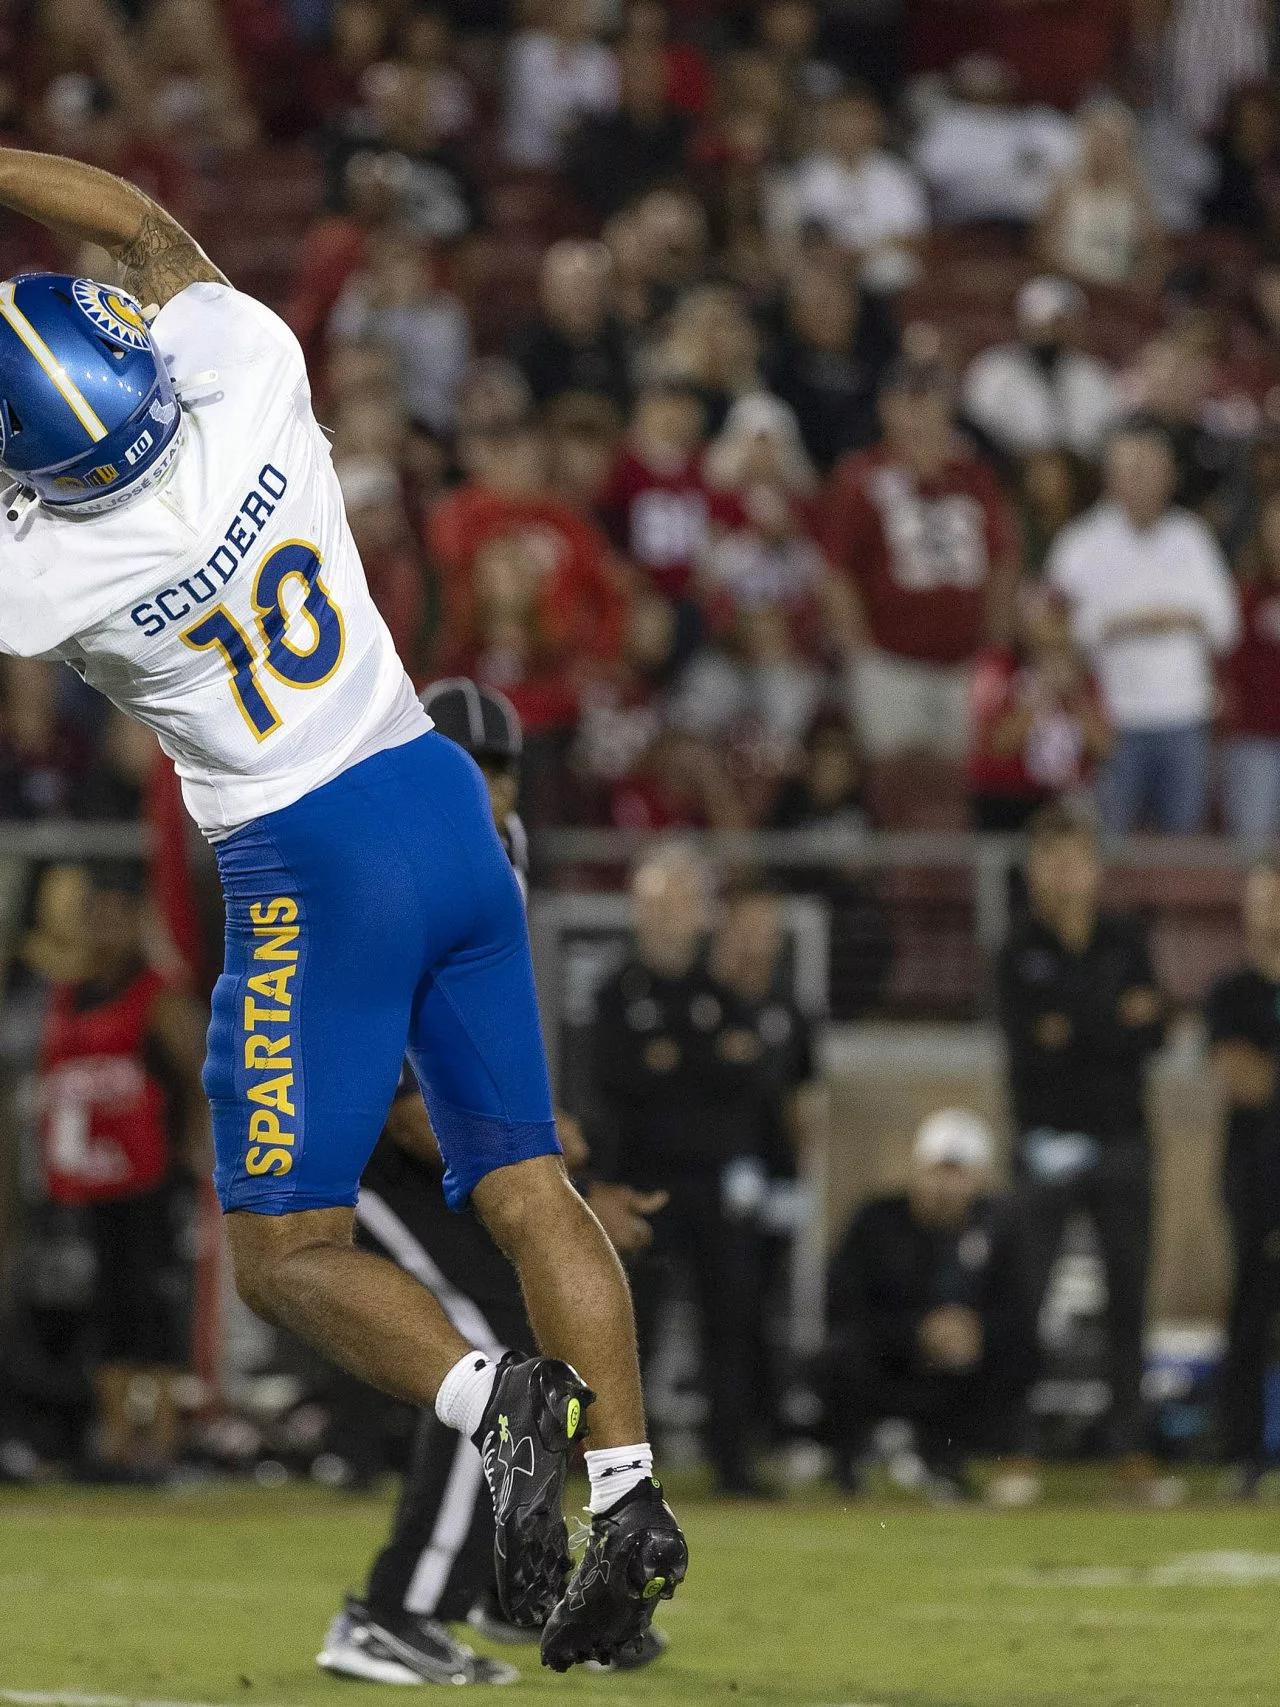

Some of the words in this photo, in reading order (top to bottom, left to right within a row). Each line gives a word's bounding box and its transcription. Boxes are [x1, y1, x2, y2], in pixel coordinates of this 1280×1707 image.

[131, 436, 149, 461] 10
[153, 431, 182, 478] STAT
[131, 463, 287, 637] SCUDERO
[177, 537, 346, 744] 10
[244, 897, 300, 1176] SPARTANS
